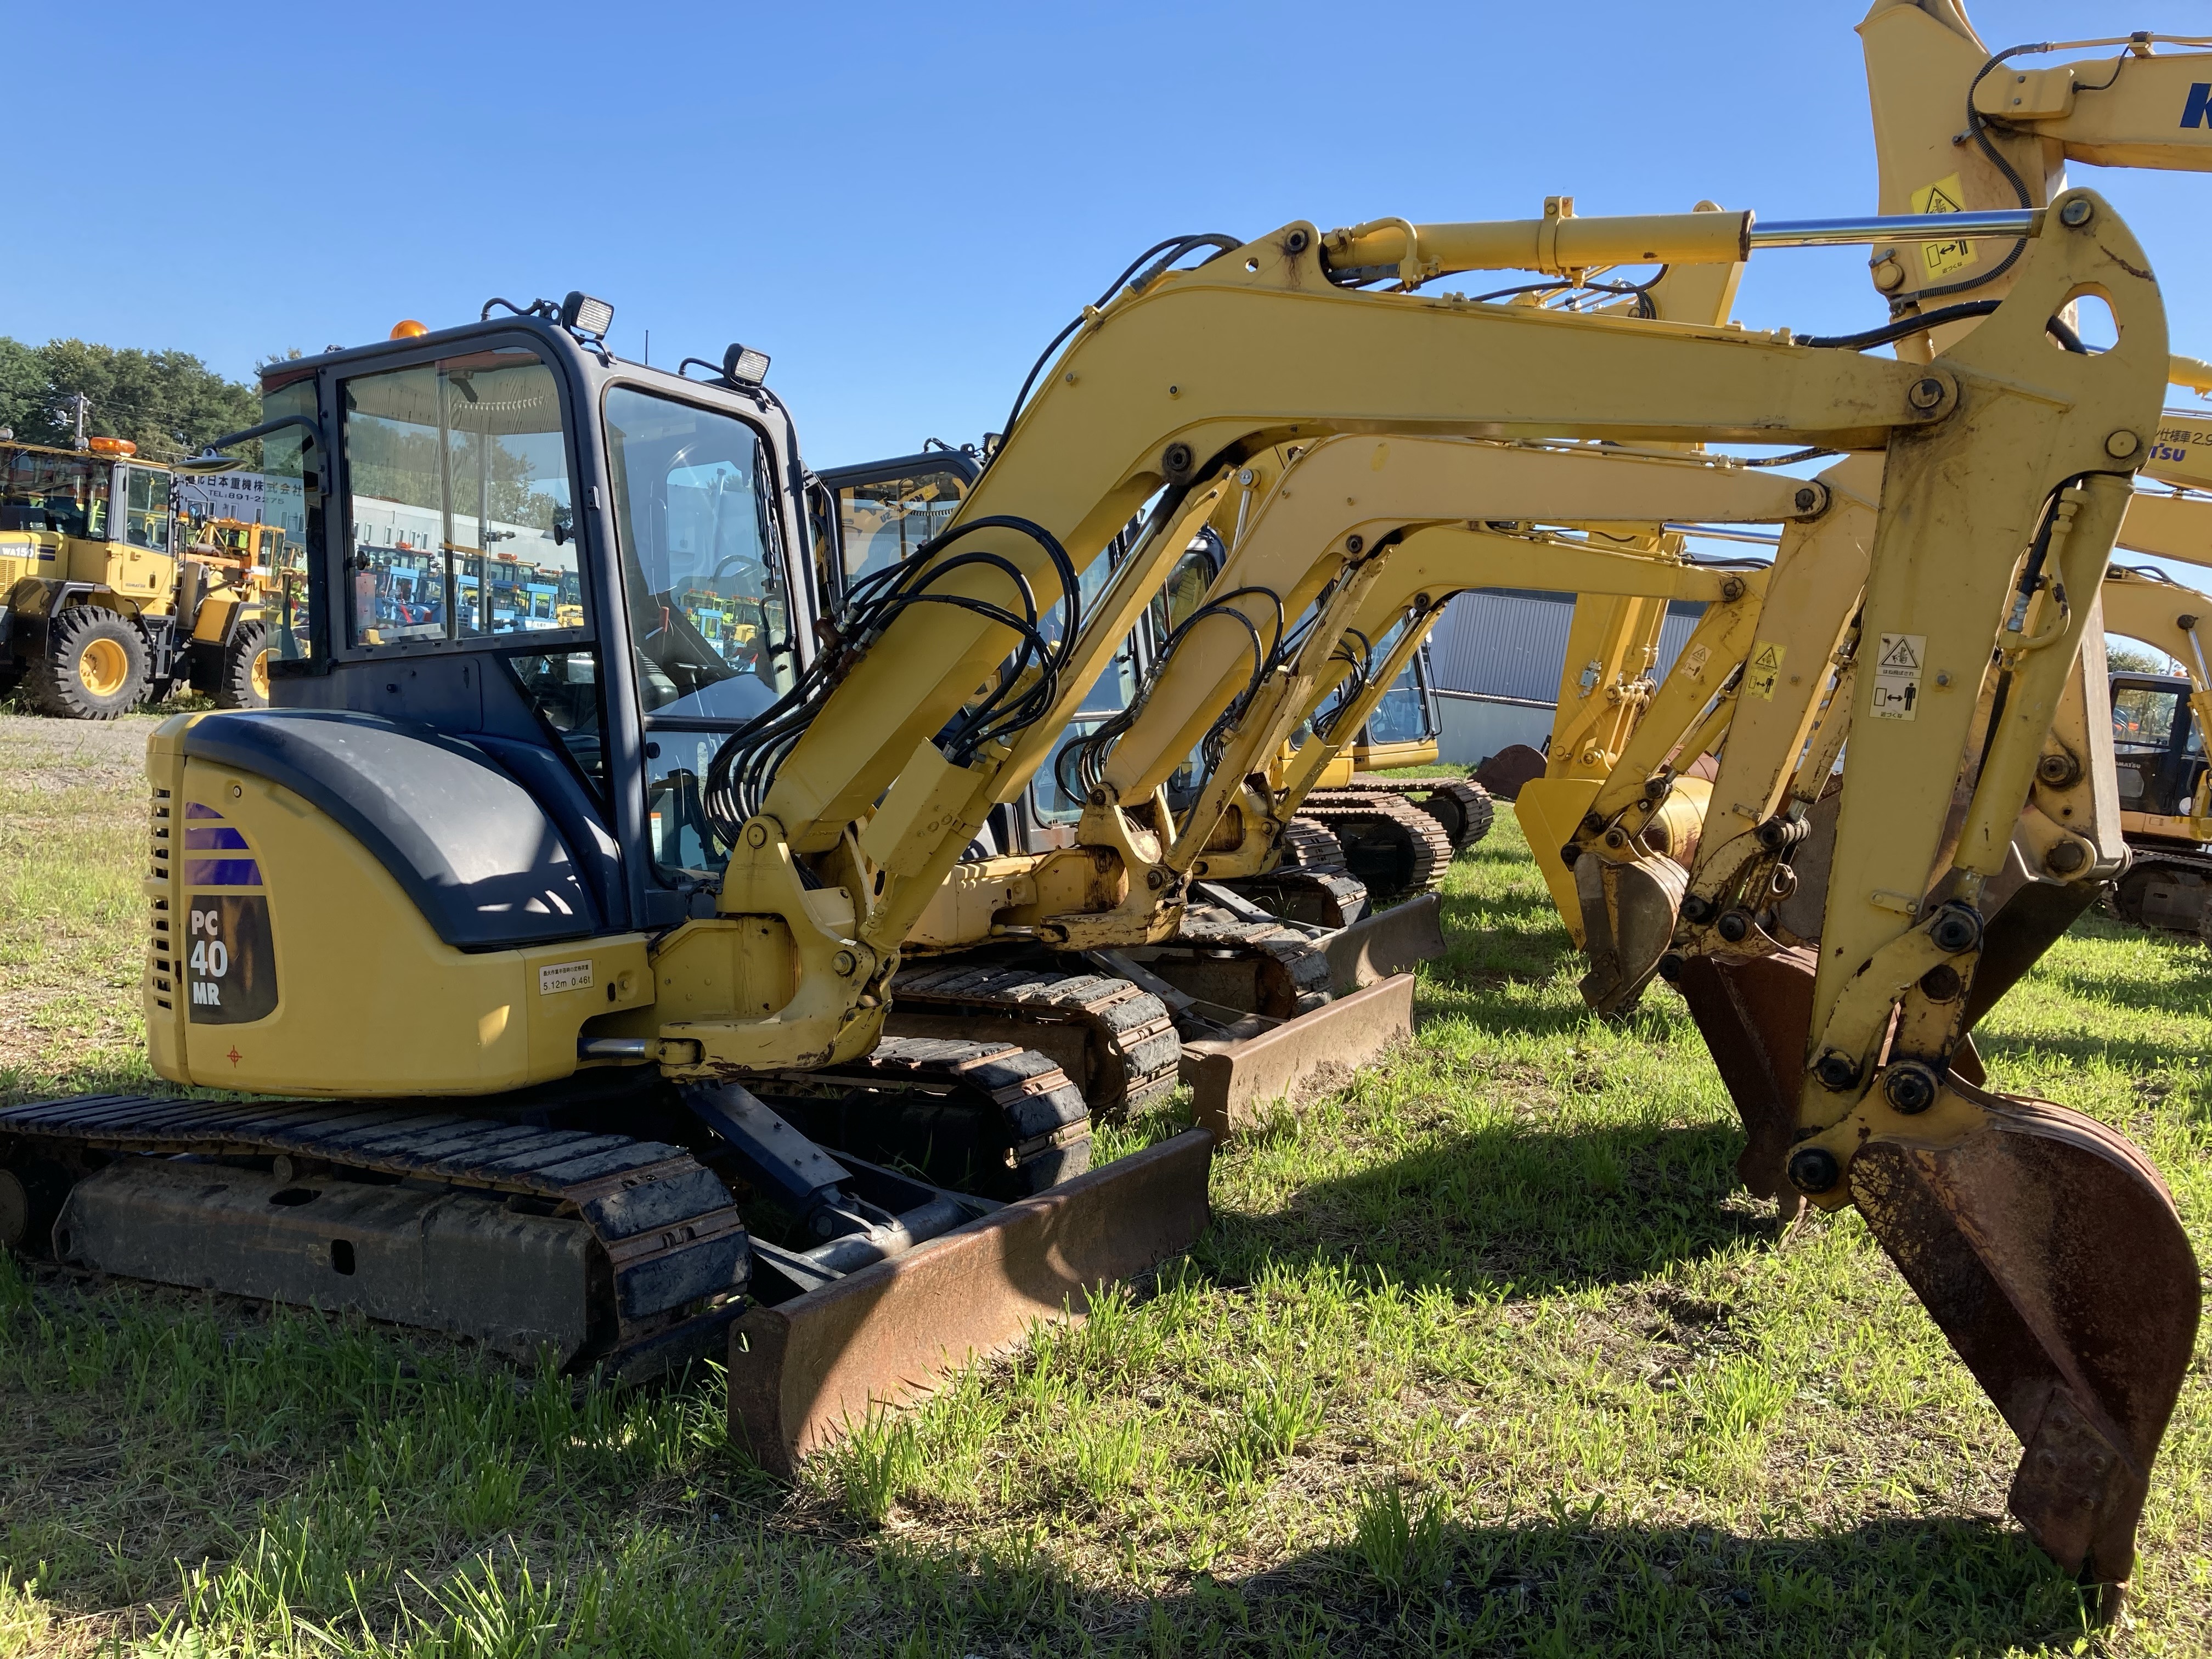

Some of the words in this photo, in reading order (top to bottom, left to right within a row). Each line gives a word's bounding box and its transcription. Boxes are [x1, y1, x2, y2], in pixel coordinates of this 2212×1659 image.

[3, 547, 34, 557] WA150
[191, 910, 218, 935] PC
[190, 940, 228, 977] 40
[193, 981, 221, 1005] MR
[544, 980, 567, 990] 5.12m
[571, 975, 590, 986] 0.46t
